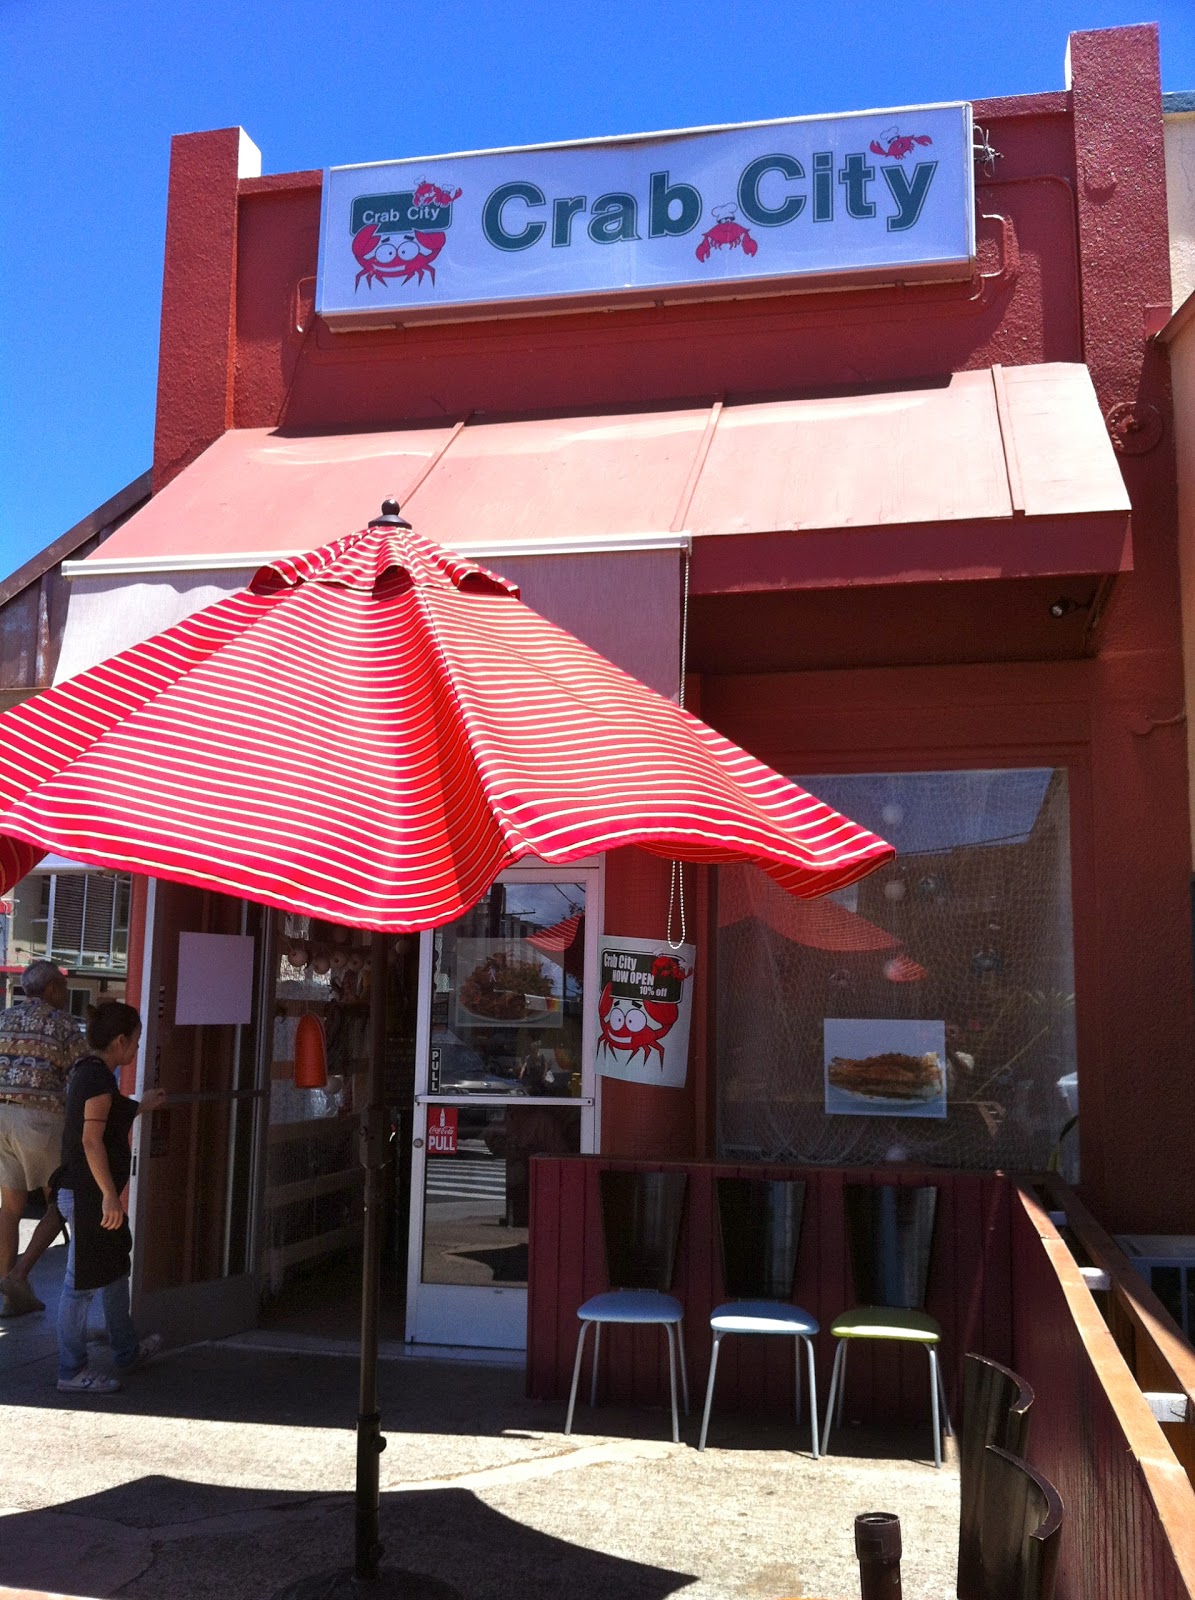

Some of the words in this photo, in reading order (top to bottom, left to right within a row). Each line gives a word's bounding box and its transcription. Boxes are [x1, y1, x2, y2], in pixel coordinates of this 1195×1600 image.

[482, 171, 702, 251] Crab
[738, 152, 939, 233] City
[362, 208, 400, 224] Crab
[407, 205, 440, 221] City
[604, 953, 618, 967] Crab
[618, 955, 637, 971] City
[612, 970, 629, 984] NOW
[630, 972, 654, 986] OPEN
[639, 985, 654, 996] 10%
[656, 988, 668, 997] off
[431, 1051, 439, 1091] PULL
[428, 1136, 455, 1151] PULL
